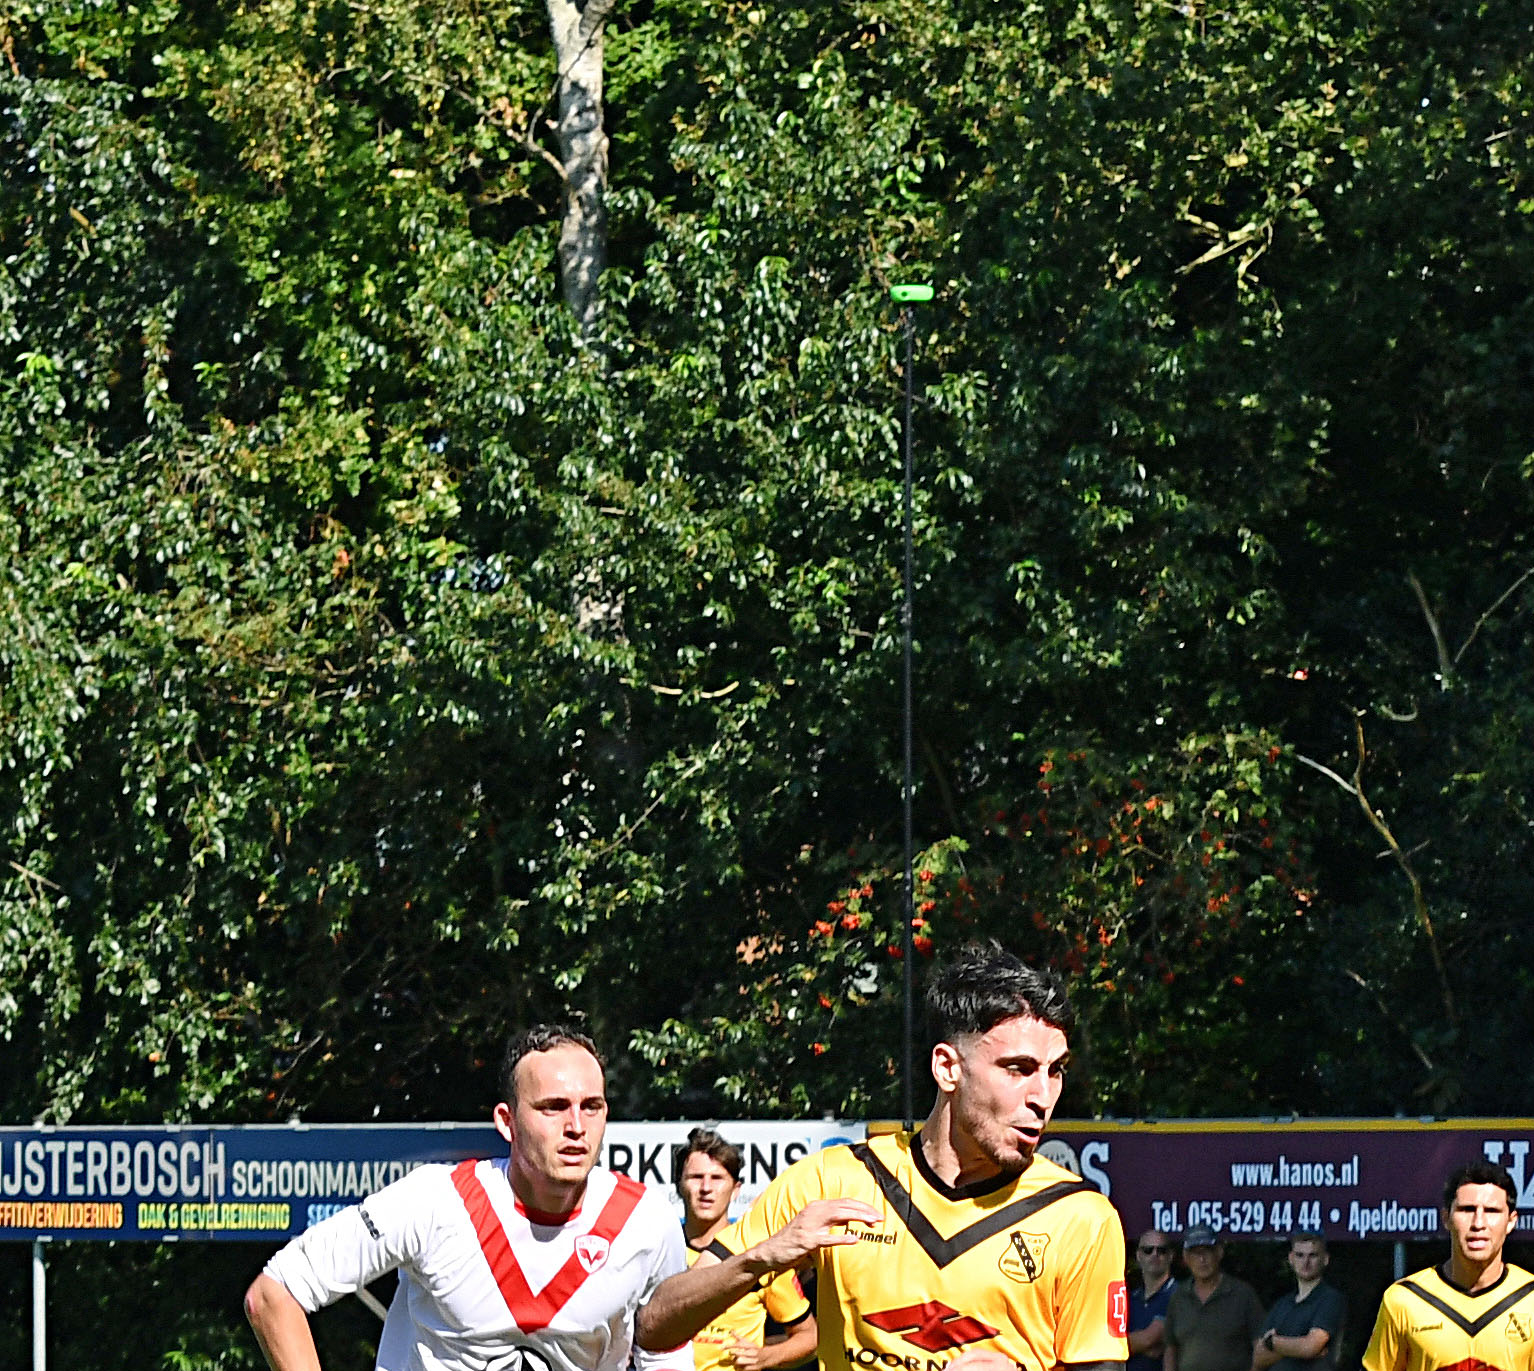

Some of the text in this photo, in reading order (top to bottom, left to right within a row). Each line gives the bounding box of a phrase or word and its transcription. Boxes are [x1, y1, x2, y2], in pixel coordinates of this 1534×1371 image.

[0, 1140, 424, 1197] JSTERBOSCH SCHOONMAAKD
[1231, 1154, 1359, 1187] www.hanos.nl
[138, 1203, 166, 1229] DAK
[1151, 1201, 1438, 1239] Tel. 055-529 44 44 Apeldoorn
